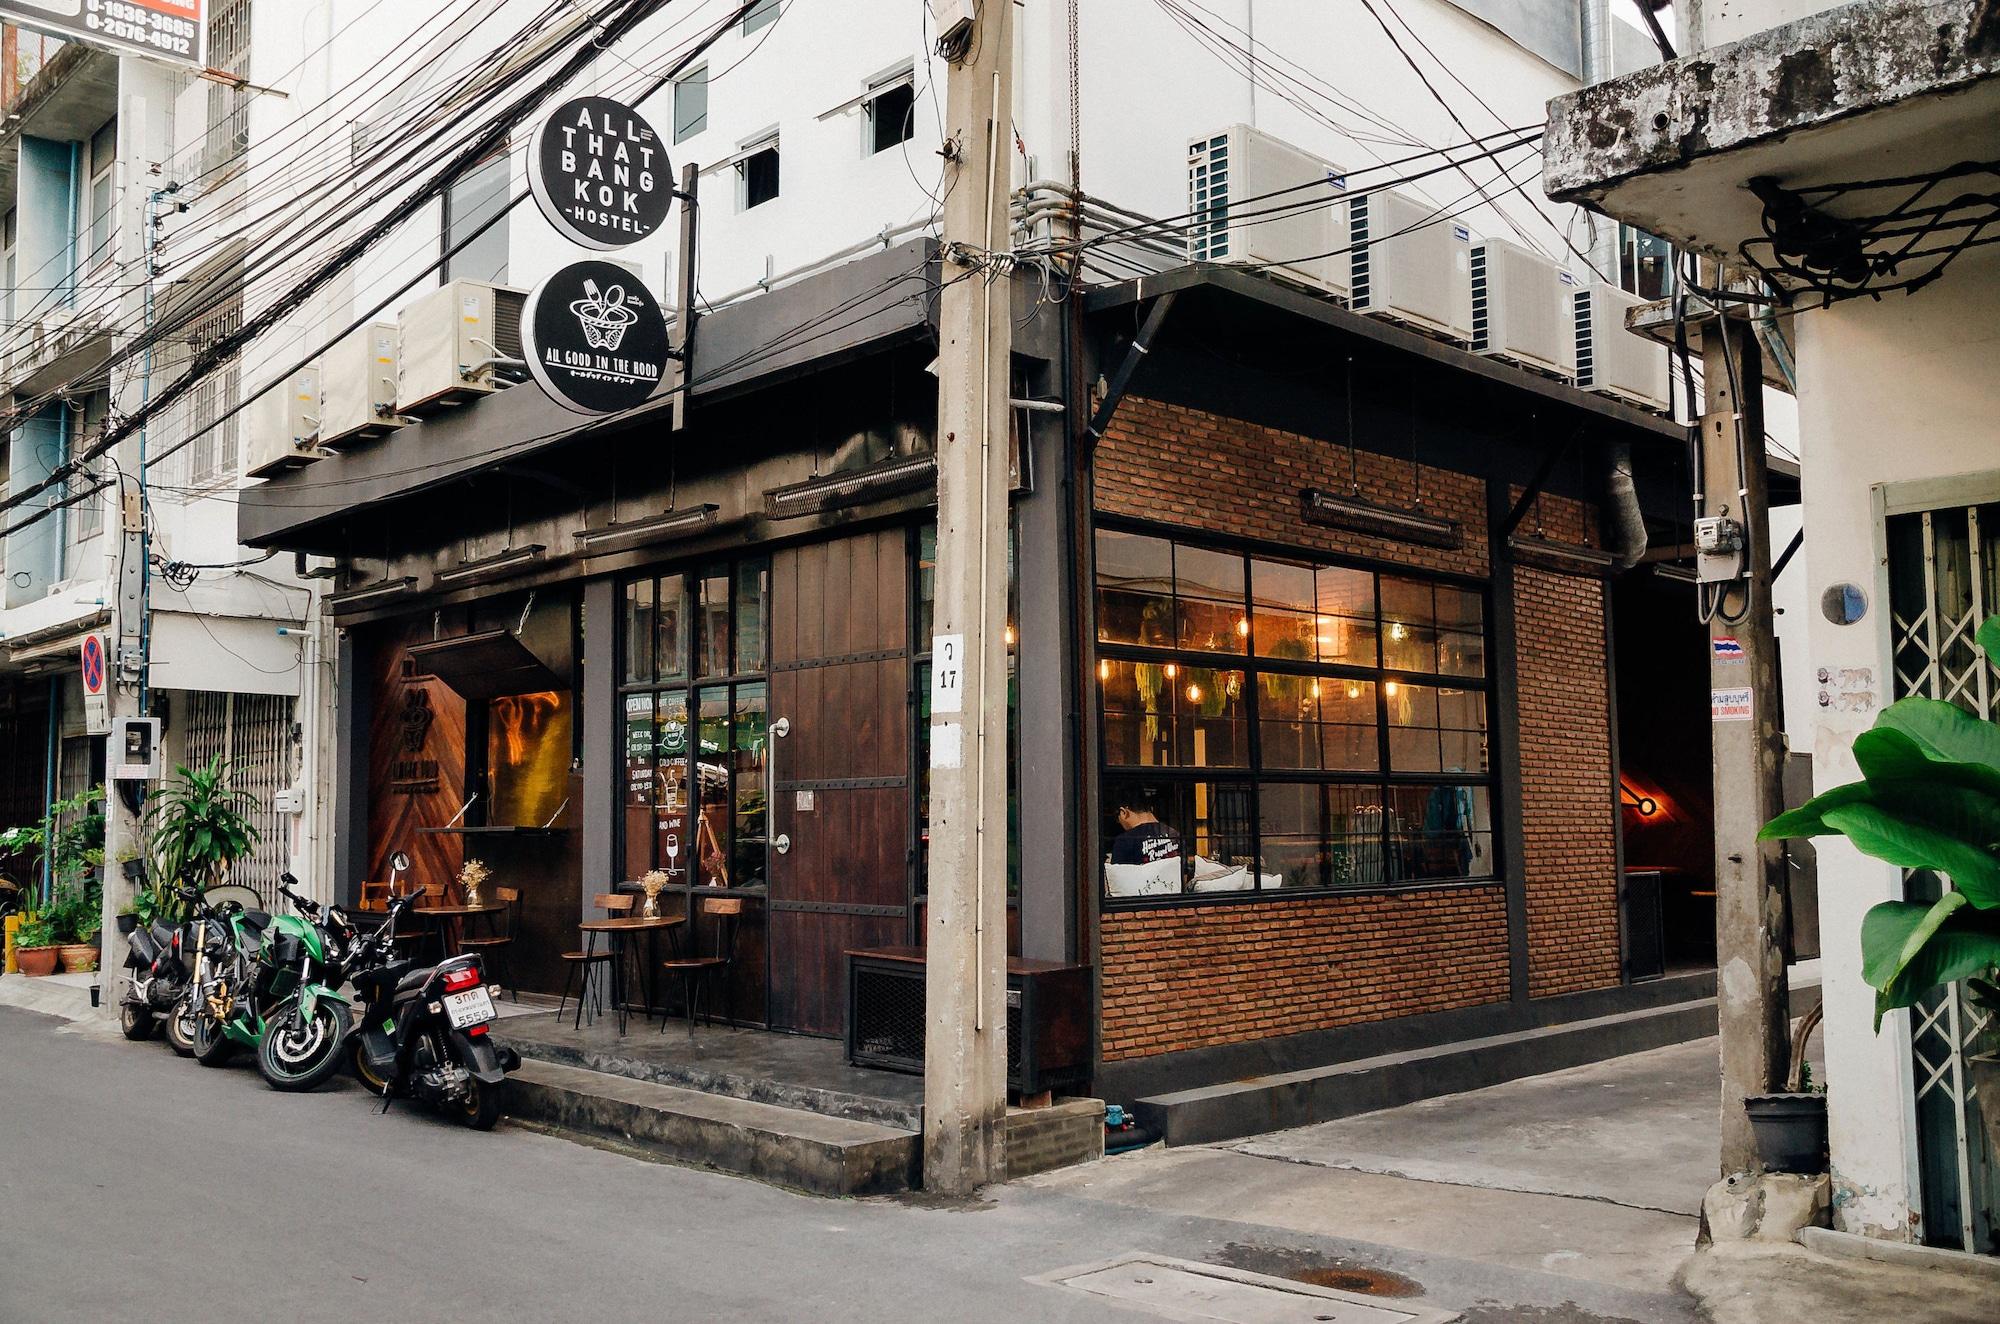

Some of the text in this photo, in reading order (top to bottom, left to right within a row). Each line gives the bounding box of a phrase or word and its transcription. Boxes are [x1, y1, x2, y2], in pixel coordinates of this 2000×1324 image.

[86, 13, 190, 55] 0-2676-4912
[577, 107, 641, 142] ALL
[562, 126, 653, 168] THAT
[561, 150, 653, 192] BANG
[574, 178, 639, 214] KOK
[546, 347, 658, 377] ALL GOOD IN THE HOOD
[940, 670, 956, 689] 17
[626, 698, 640, 712] OPEN
[1721, 705, 1749, 716] SMOKING
[659, 819, 681, 830] AND WINE
[458, 1009, 489, 1026] 5559
